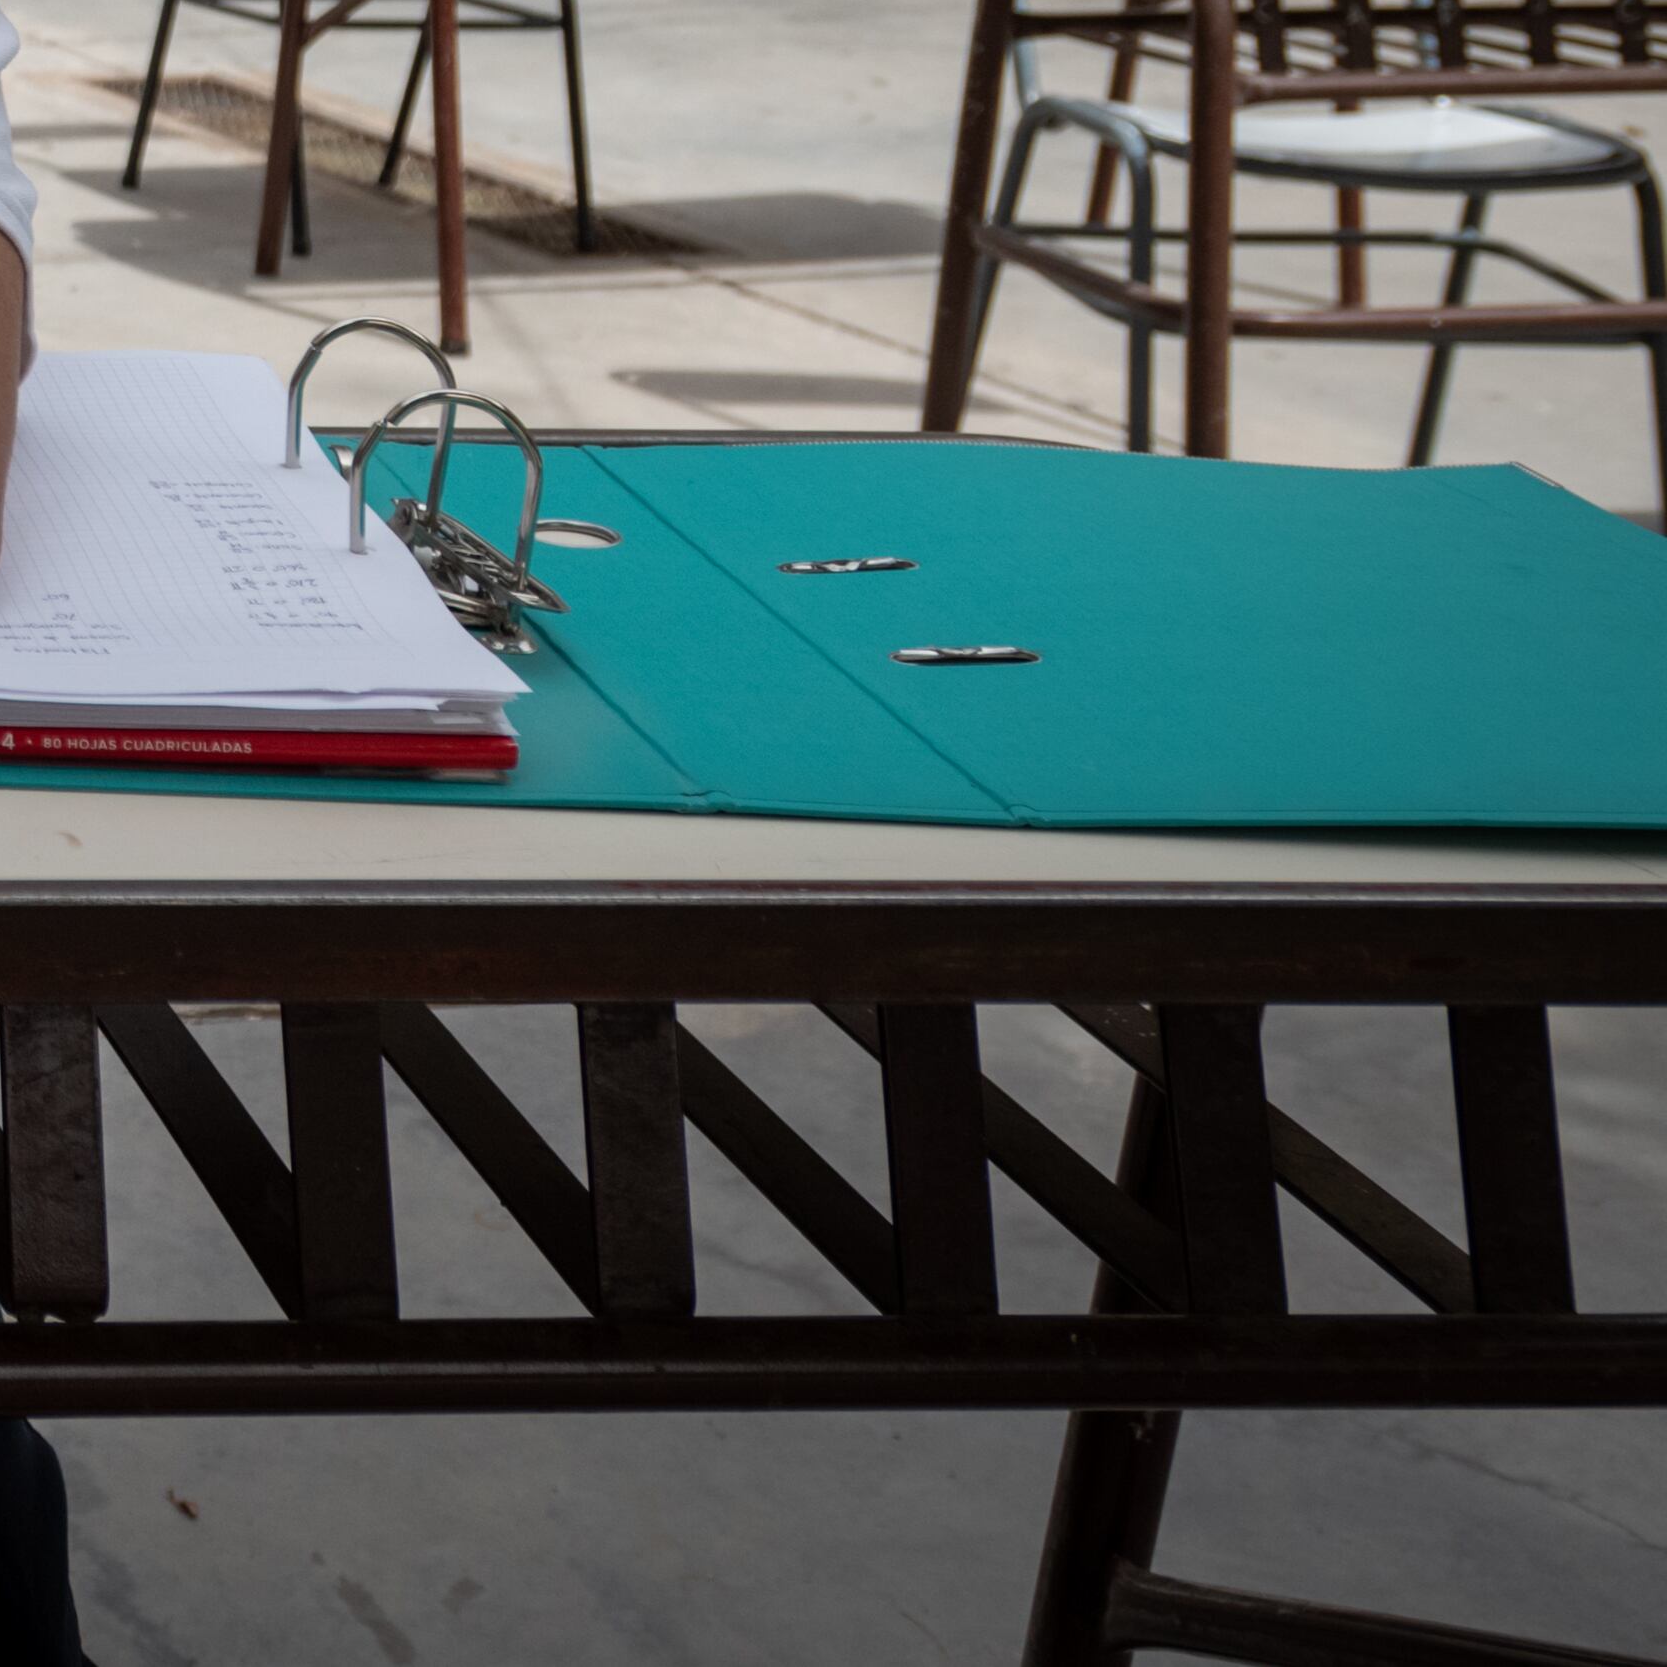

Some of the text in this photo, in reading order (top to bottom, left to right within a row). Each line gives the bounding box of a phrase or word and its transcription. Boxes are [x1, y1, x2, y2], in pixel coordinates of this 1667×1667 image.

[42, 736, 62, 749] 80
[67, 737, 117, 751] HOJAS
[122, 739, 253, 754] CUADRICULADAS
